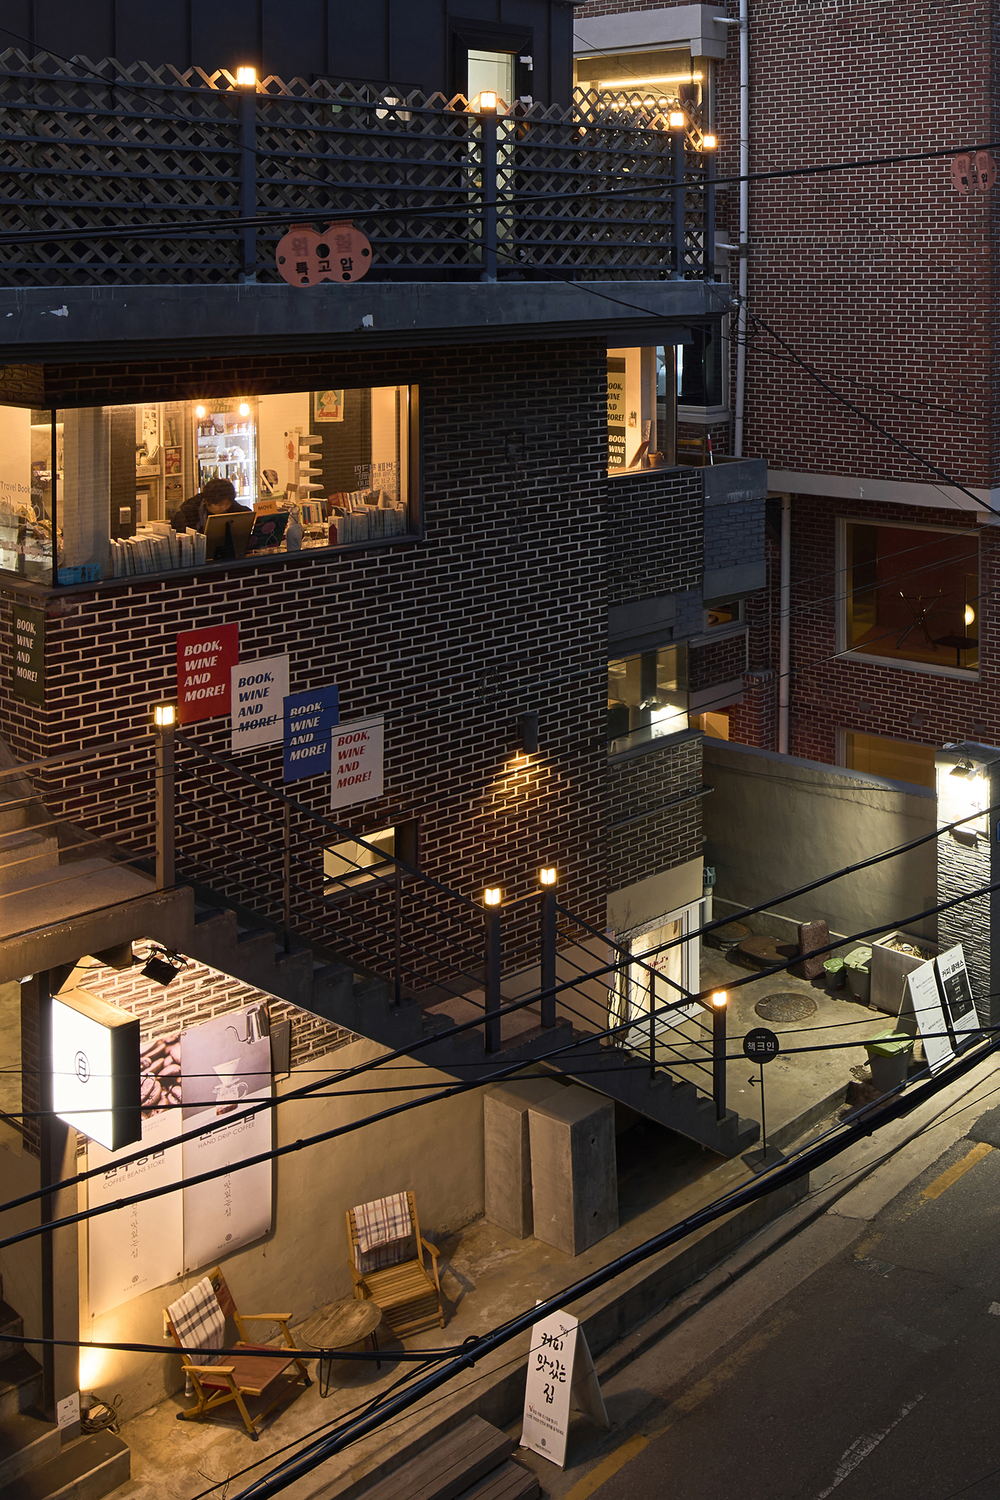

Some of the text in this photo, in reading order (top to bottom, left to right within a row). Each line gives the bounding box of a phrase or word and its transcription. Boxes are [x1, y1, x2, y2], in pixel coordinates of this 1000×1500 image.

[296, 257, 354, 275] 특고압
[608, 445, 625, 454] WINE
[608, 455, 622, 464] AND
[257, 503, 273, 511] MOVE
[16, 618, 37, 636] BOOK,
[16, 634, 34, 649] WINE
[183, 640, 223, 657] BOOK,
[16, 650, 30, 664] AND
[184, 655, 218, 672] WINE
[16, 666, 38, 682] MORE!
[183, 672, 211, 687] AND
[237, 671, 274, 688] BOOK,
[184, 683, 226, 702] MORE!
[238, 686, 270, 703] WINE
[237, 703, 264, 718] AND
[289, 701, 325, 719] BOOK,
[238, 714, 278, 733] MORE!
[290, 716, 320, 733] WINE
[289, 732, 314, 747] AND
[337, 730, 370, 747] BOOK,
[289, 742, 327, 762] MORE!
[337, 745, 366, 761] WINE
[336, 760, 360, 775] AND
[336, 770, 372, 789] MORE!
[747, 1041, 775, 1052] 책크인
[197, 1137, 217, 1150] HAND
[217, 1132, 232, 1142] DRIP
[232, 1121, 256, 1136] COFFEE
[102, 1175, 126, 1190] COFFEE
[127, 1165, 147, 1180] BEANS
[146, 1158, 166, 1171] STORE
[541, 1332, 563, 1351] 커피
[536, 1353, 566, 1383] 맛있는
[543, 1383, 555, 1404] 집
